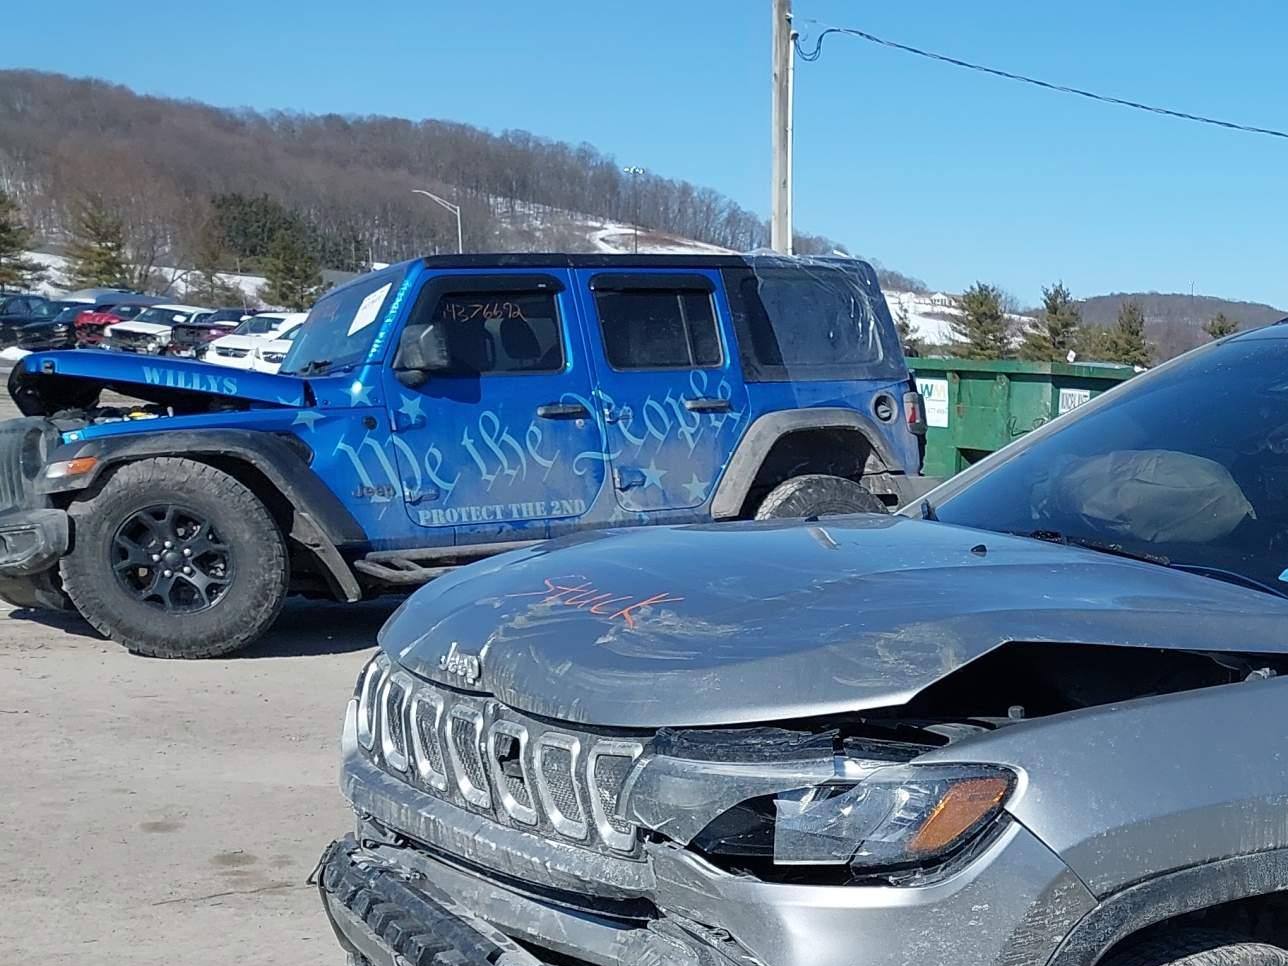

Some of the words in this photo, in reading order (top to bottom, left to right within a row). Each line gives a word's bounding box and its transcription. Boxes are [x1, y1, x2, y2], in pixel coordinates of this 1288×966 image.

[142, 366, 238, 395] WILLYS
[418, 505, 505, 525] PROTECT
[508, 502, 546, 518] THE
[550, 499, 587, 515] 2ND
[439, 642, 480, 684] Jeep
